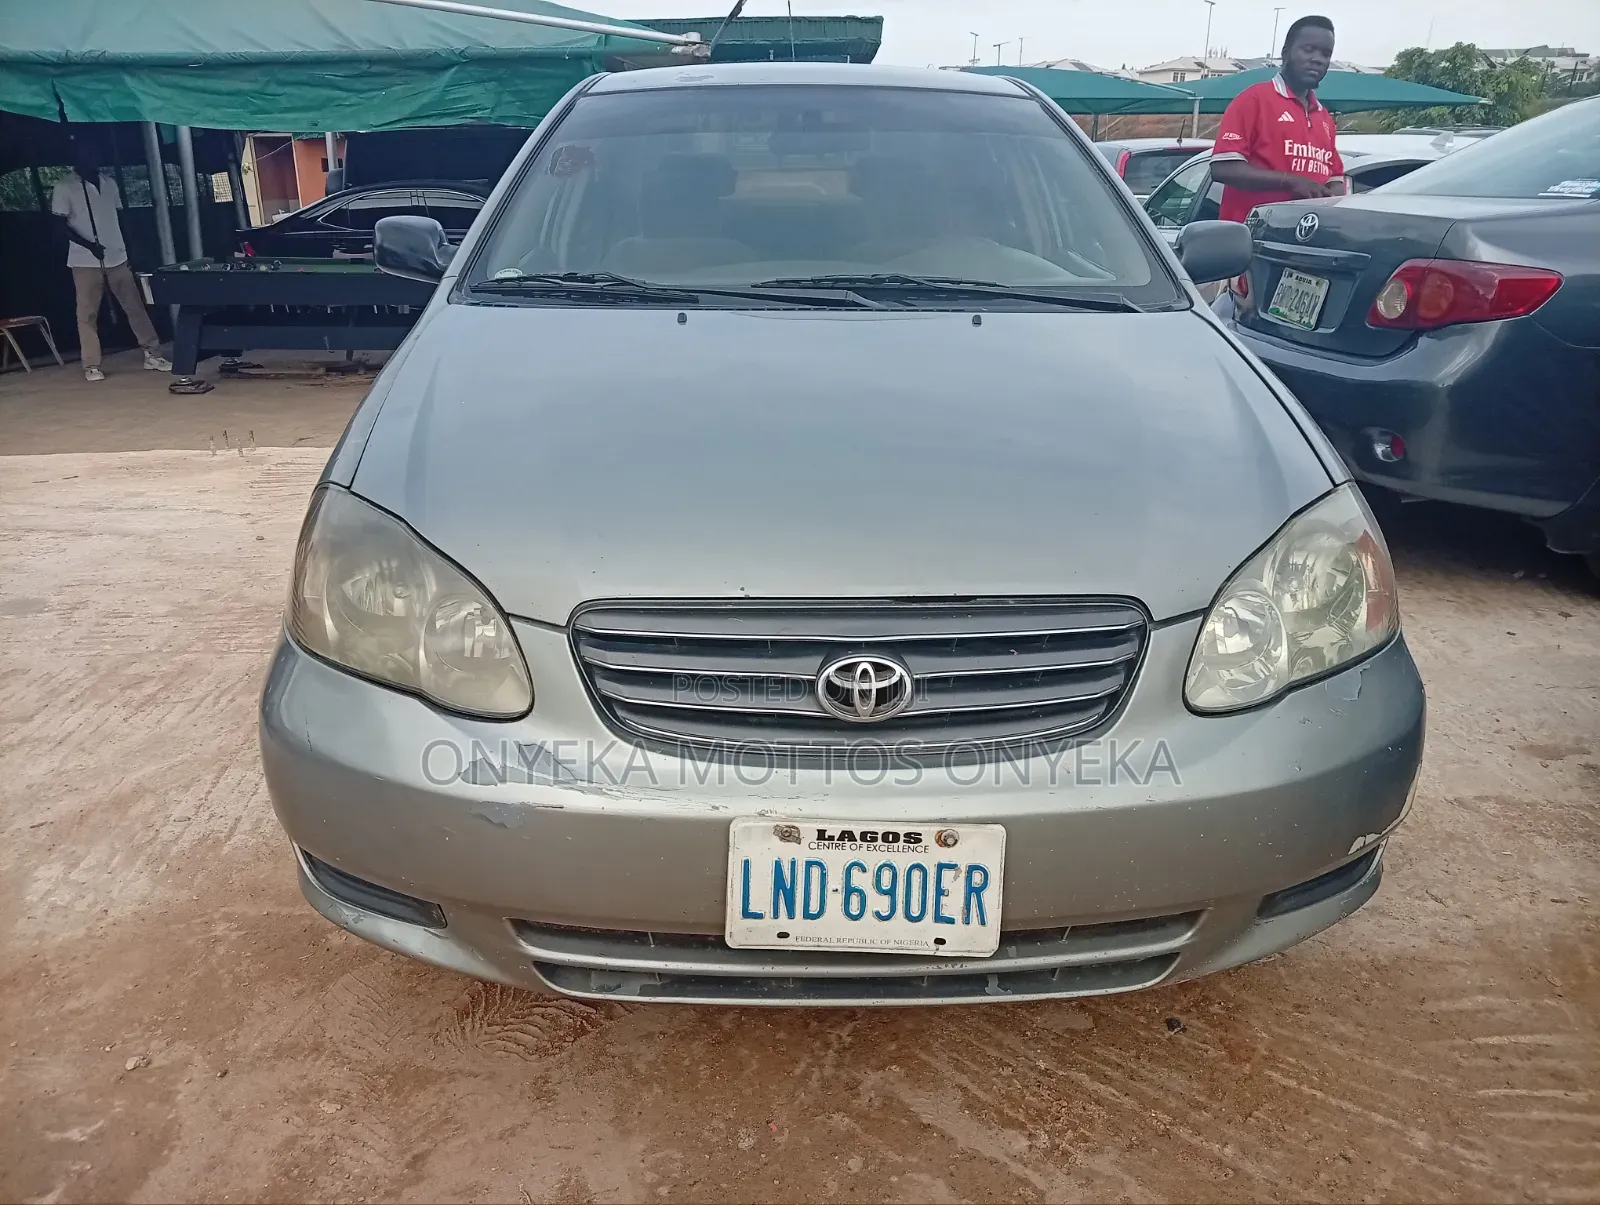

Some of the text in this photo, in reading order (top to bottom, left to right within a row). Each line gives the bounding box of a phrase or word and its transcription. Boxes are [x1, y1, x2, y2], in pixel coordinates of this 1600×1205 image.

[1284, 139, 1334, 166] Emirate
[1291, 158, 1307, 172] FLY
[816, 829, 923, 845] LAGOS
[808, 841, 930, 853] CENTRE OF EXCELLENCE
[740, 857, 991, 926] LND-690ER
[795, 935, 834, 944] FEDERAL
[836, 937, 878, 945] REPUBLIC
[893, 939, 930, 947] NIGERIA
